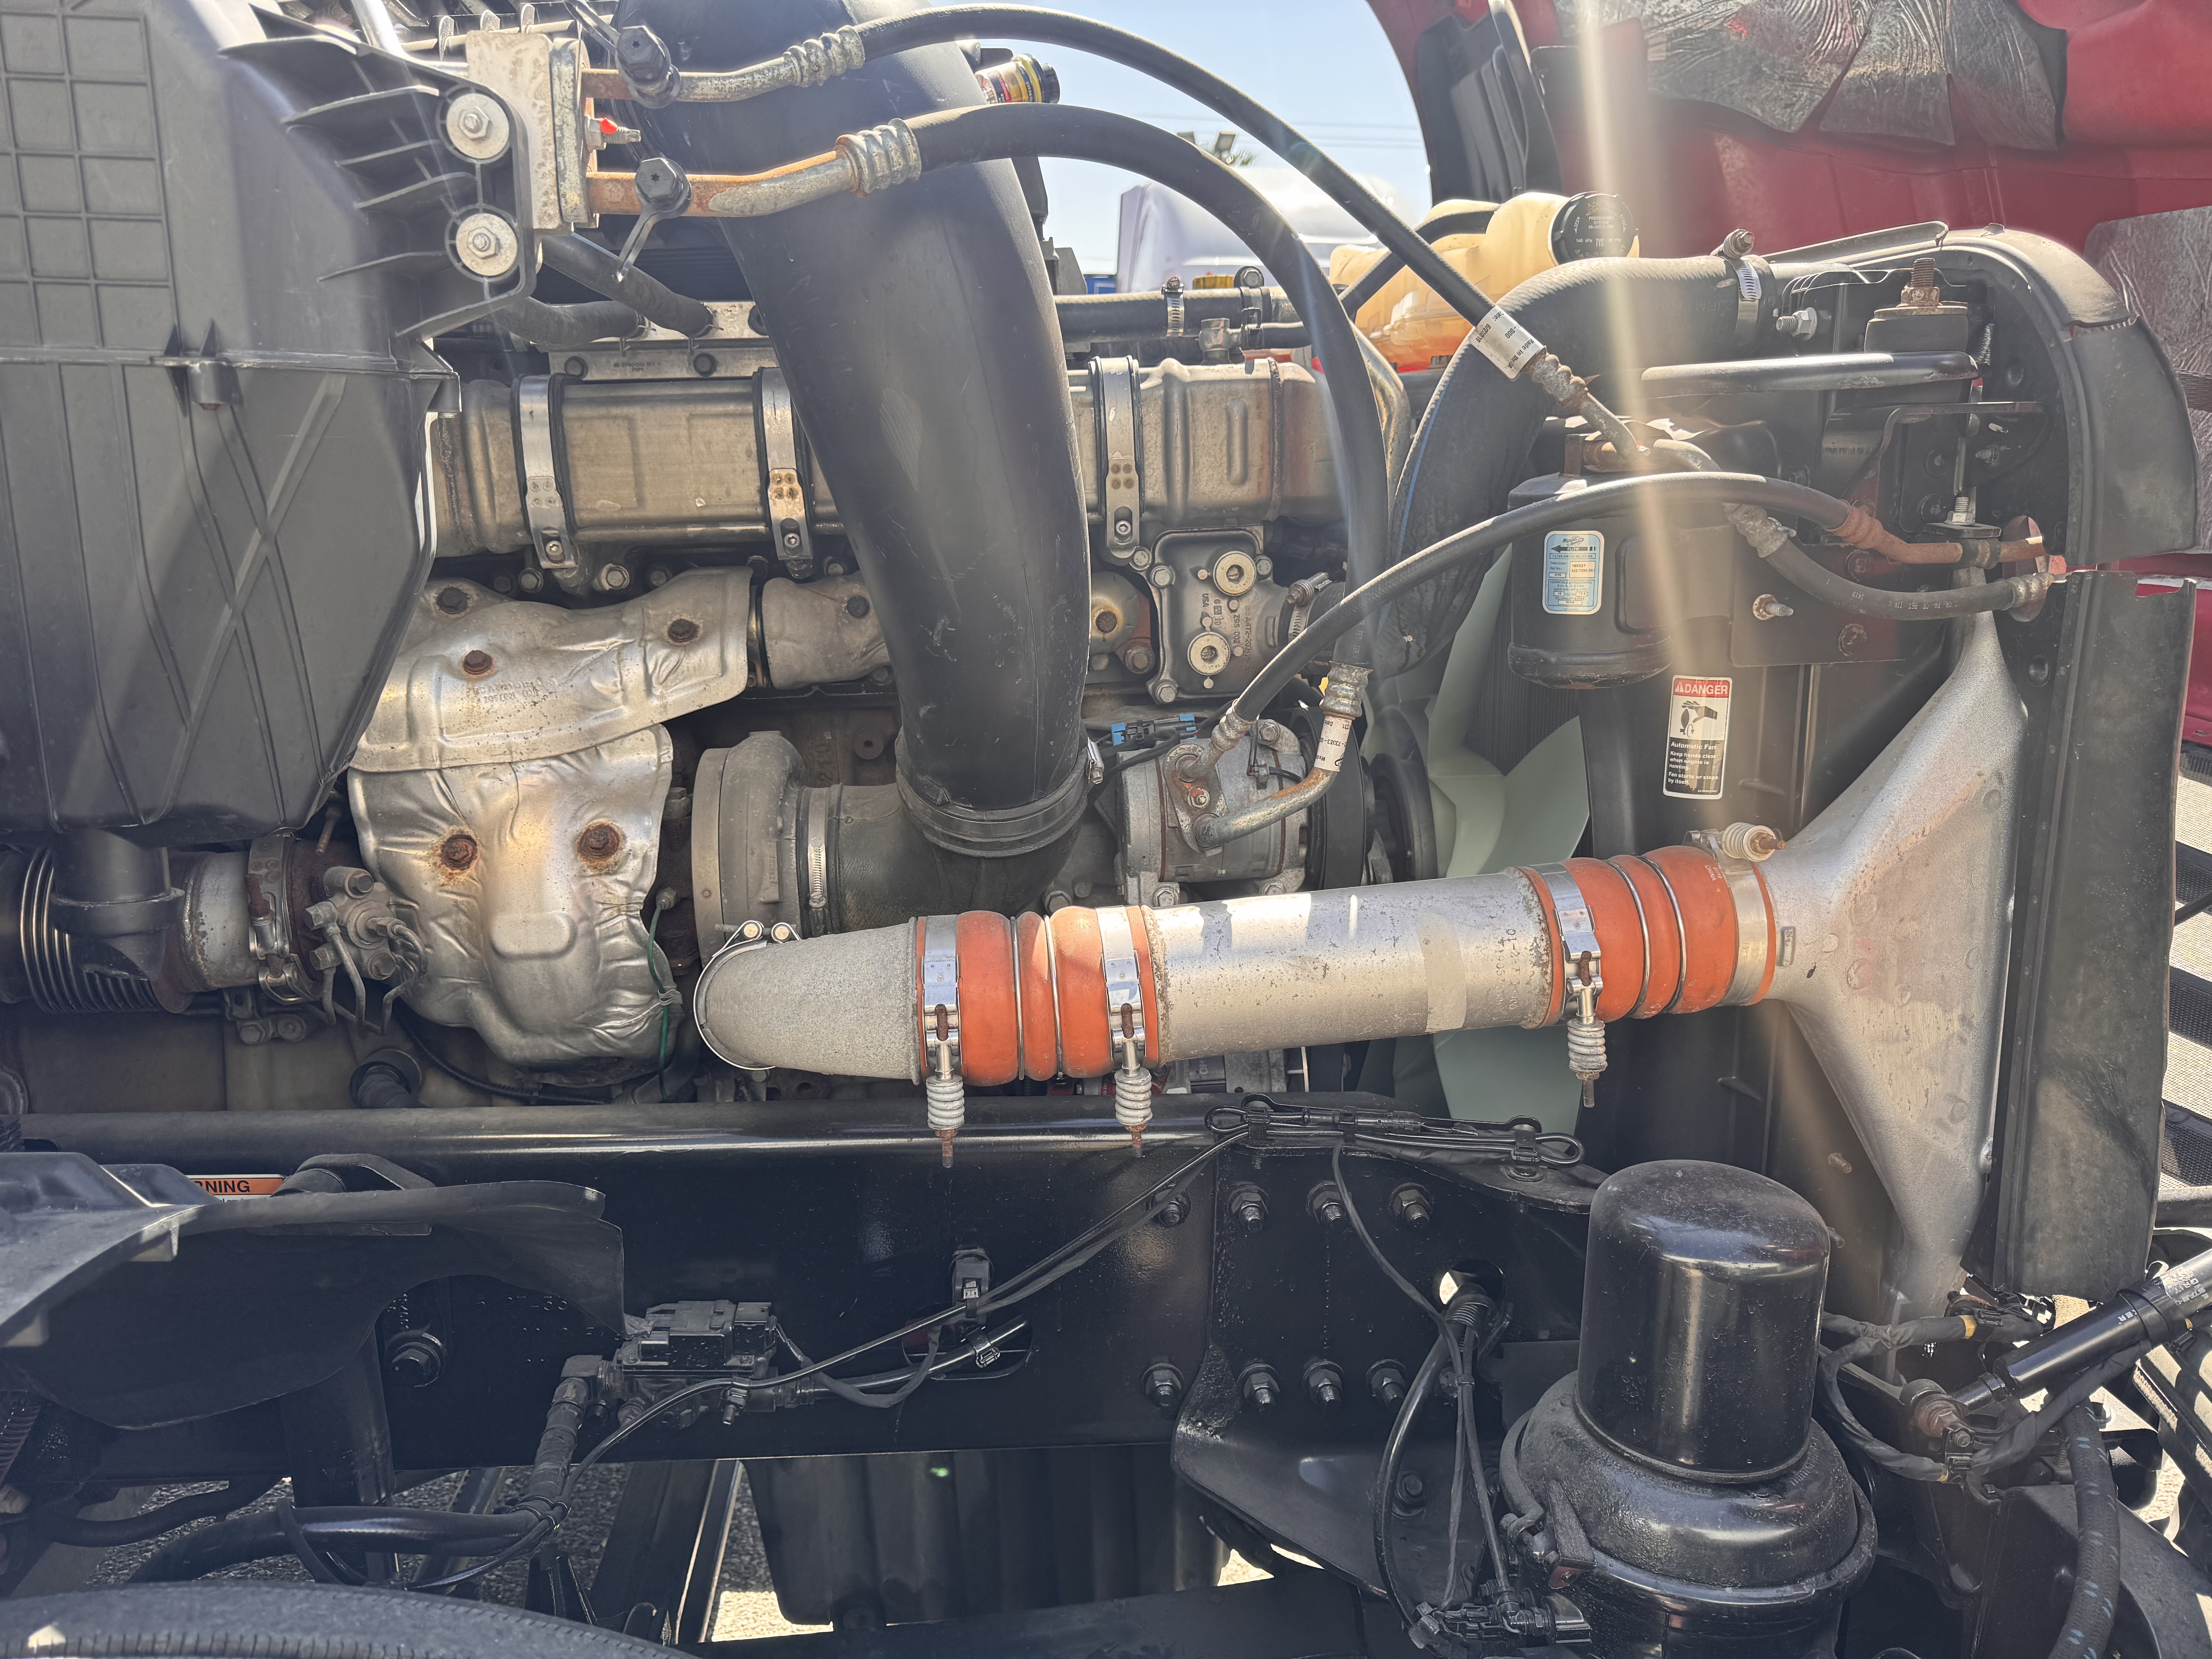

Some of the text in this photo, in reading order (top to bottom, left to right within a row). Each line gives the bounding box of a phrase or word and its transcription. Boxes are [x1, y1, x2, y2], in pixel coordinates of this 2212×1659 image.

[1685, 683, 1728, 695] DANGER
[1671, 741, 1703, 750] Automatic
[1705, 865, 1717, 881] CHINA
